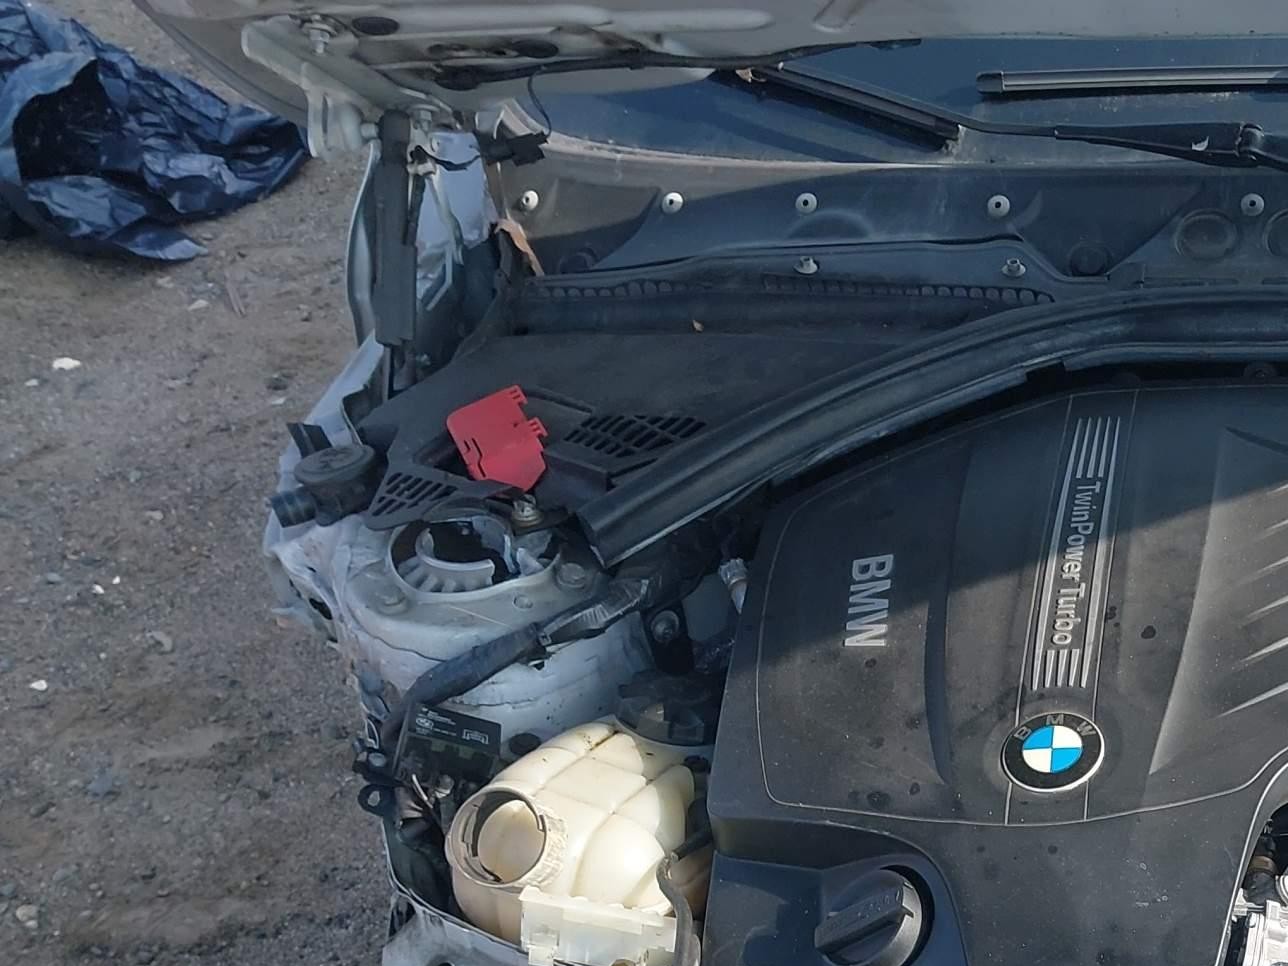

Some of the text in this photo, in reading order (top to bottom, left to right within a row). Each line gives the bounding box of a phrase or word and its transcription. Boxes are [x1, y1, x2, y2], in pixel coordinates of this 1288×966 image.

[844, 553, 894, 647] BMW
[1052, 481, 1101, 646] TwinPower Turbo
[1013, 713, 1097, 741] BMW
